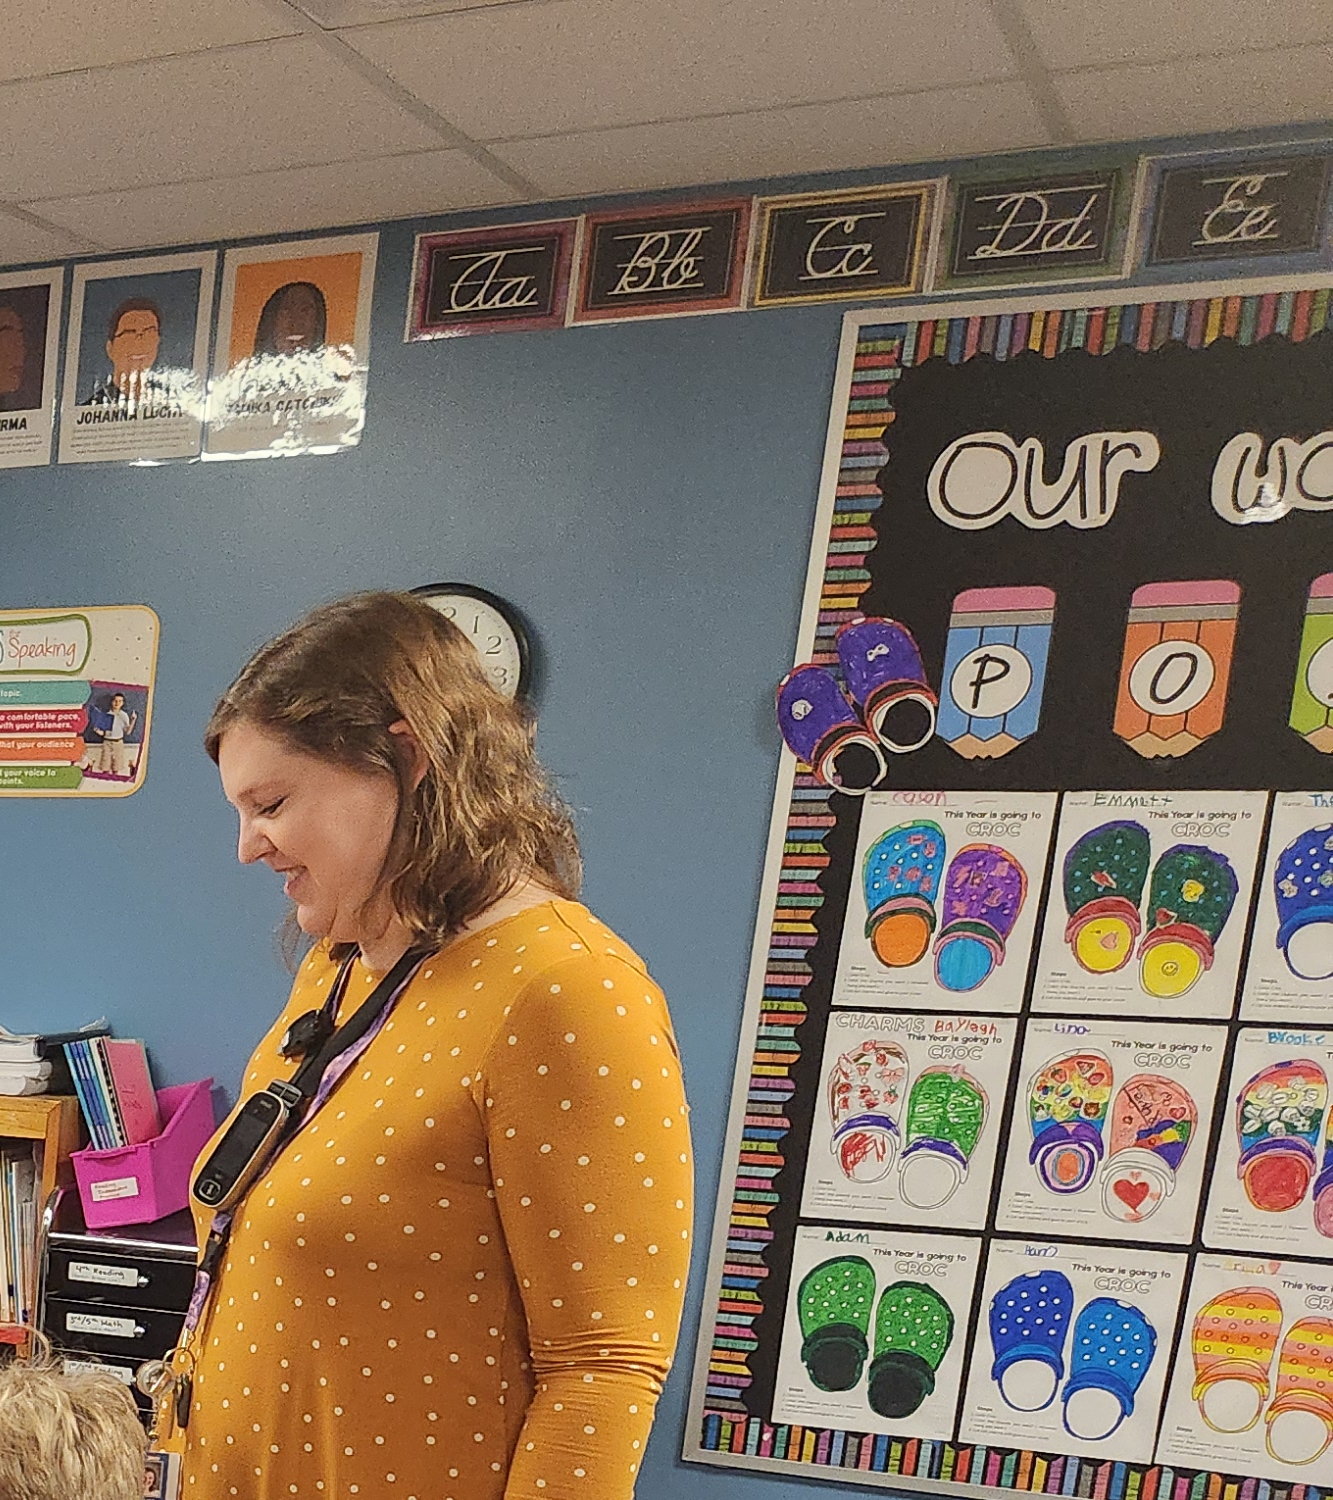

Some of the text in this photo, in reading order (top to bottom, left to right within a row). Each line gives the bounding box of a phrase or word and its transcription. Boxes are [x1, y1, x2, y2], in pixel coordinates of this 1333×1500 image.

[975, 192, 1097, 257] Dd
[807, 217, 872, 276] Cc
[615, 229, 701, 293] Bb
[451, 252, 536, 312] Aa
[77, 405, 138, 425] JOHANNA
[473, 615, 480, 634] 1
[8, 637, 76, 668] Speaking
[485, 635, 502, 655] 2
[493, 667, 508, 687] 3
[971, 653, 1011, 709] P
[6, 712, 56, 721] comfortable
[57, 713, 81, 722] pace,
[15, 722, 34, 731] your
[35, 721, 73, 730] listeners.
[17, 741, 36, 749] your
[37, 740, 75, 748] audience
[4, 769, 22, 778] your
[23, 769, 46, 777] voice
[944, 811, 1041, 821] This Year is going to
[1148, 811, 1252, 821] This Year is going to
[965, 821, 1022, 838] CROC
[1171, 821, 1231, 838] CROC
[835, 1013, 925, 1032] CHARMS
[907, 1033, 1002, 1045] This Year going to
[1110, 1040, 1131, 1049] This
[1133, 1041, 1155, 1049] Year
[1169, 1043, 1198, 1053] going
[1201, 1044, 1213, 1052] to
[928, 1045, 983, 1060] CROC
[1133, 1052, 1191, 1069] CROC
[873, 1249, 891, 1257] This
[894, 1249, 915, 1258] Year
[927, 1252, 954, 1262] going
[94, 1268, 125, 1279] Reading
[894, 1260, 948, 1277] CROC
[1072, 1263, 1092, 1271] This
[1094, 1265, 1116, 1273] Year
[1128, 1268, 1157, 1279] going
[1161, 1270, 1171, 1278] to
[1094, 1276, 1151, 1294] CROC
[1282, 1280, 1328, 1292] This Year
[101, 1320, 123, 1328] Math
